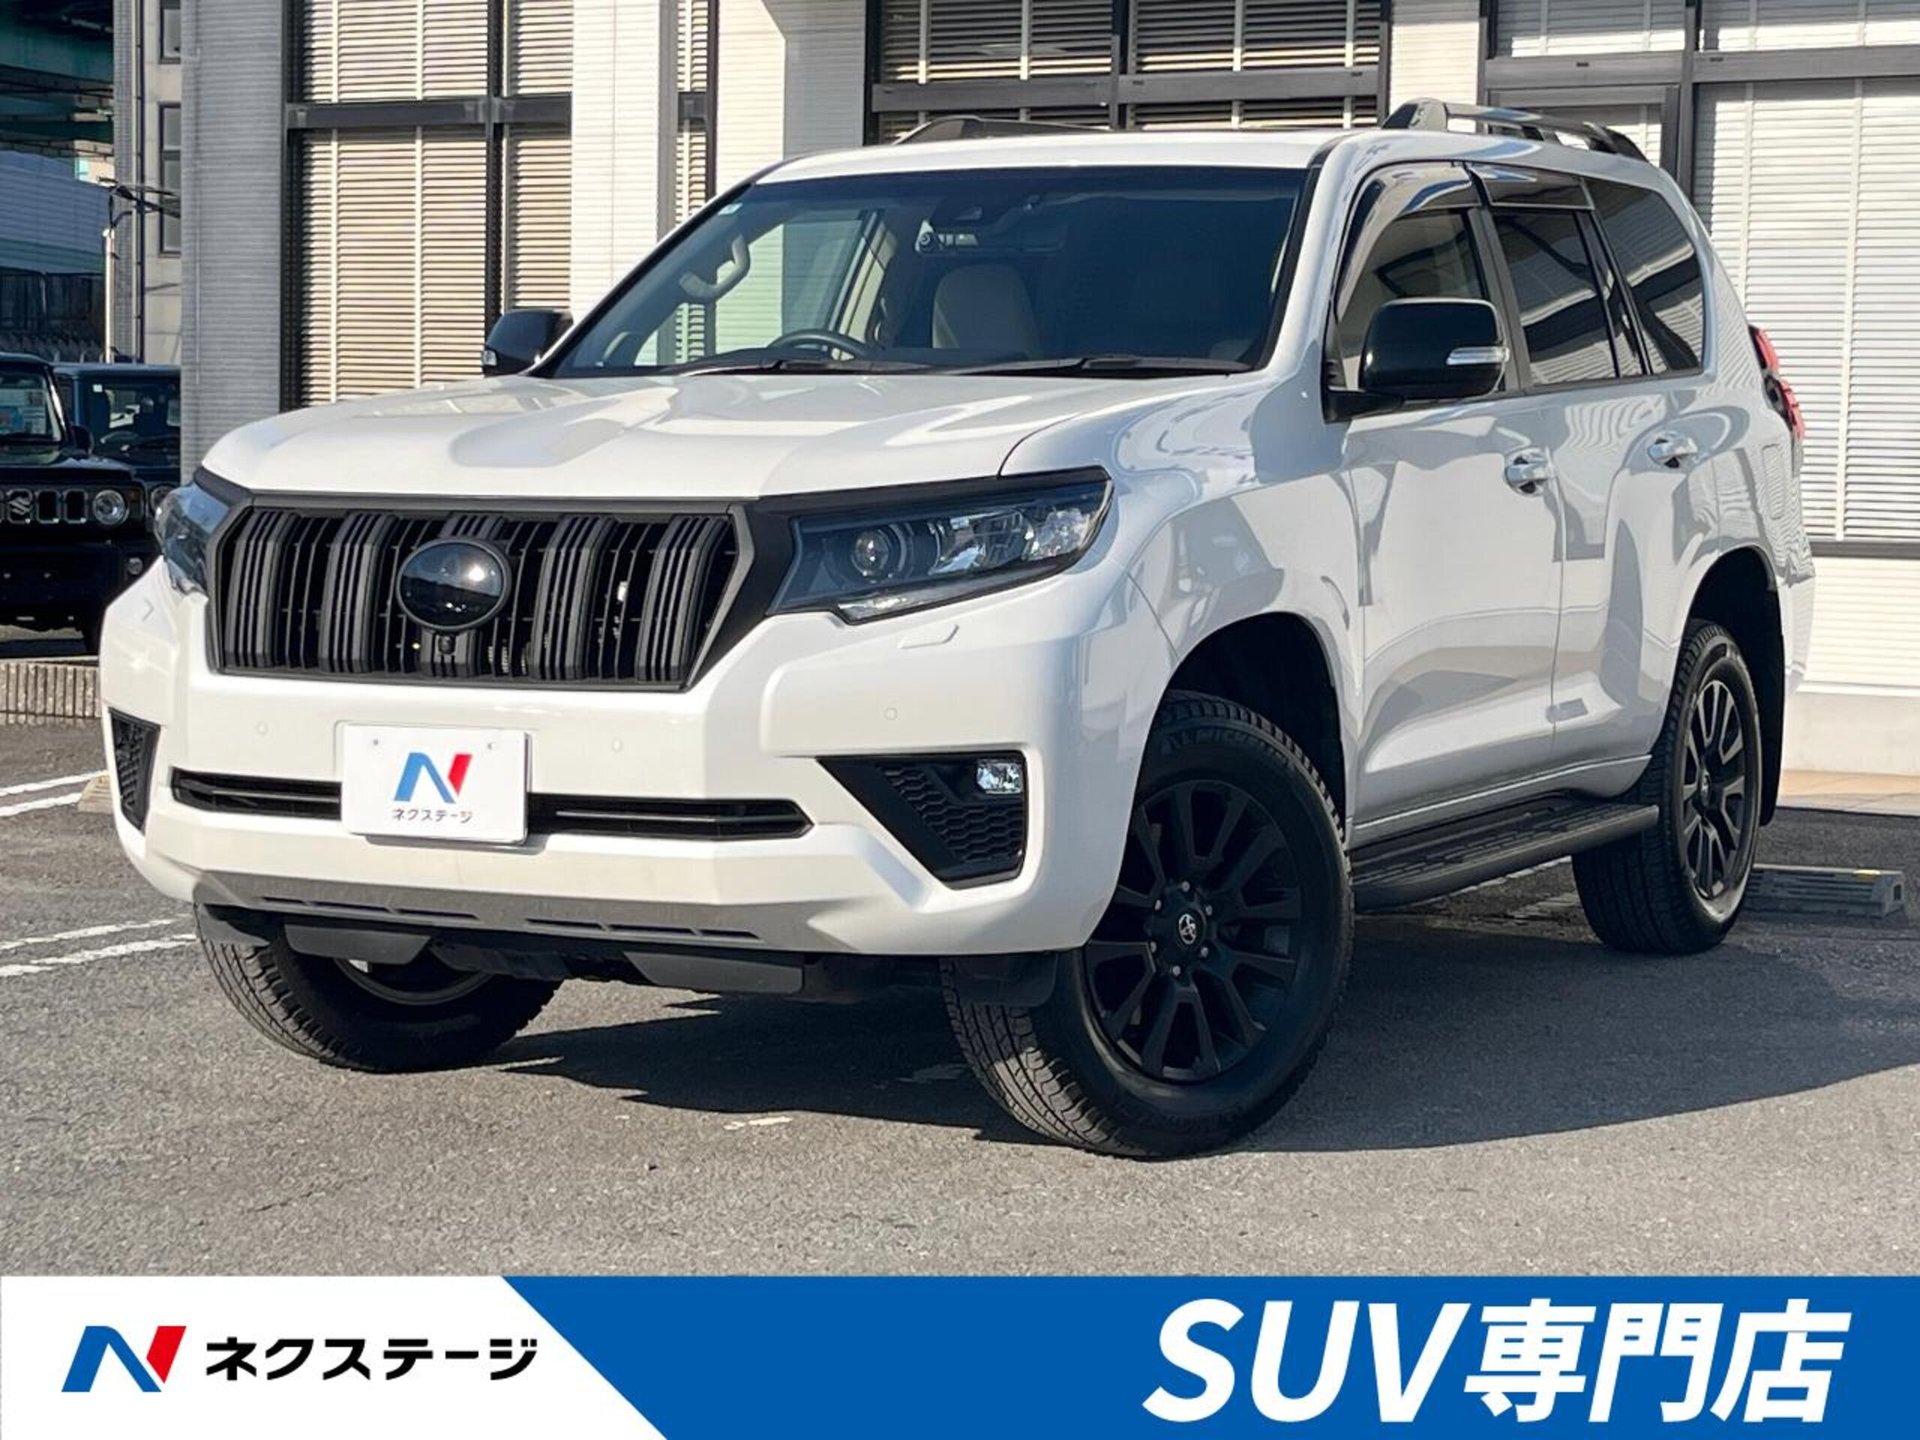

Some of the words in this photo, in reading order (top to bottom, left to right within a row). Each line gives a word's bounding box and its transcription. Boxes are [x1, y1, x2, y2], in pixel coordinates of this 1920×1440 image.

[393, 808, 473, 824] ネクステージ
